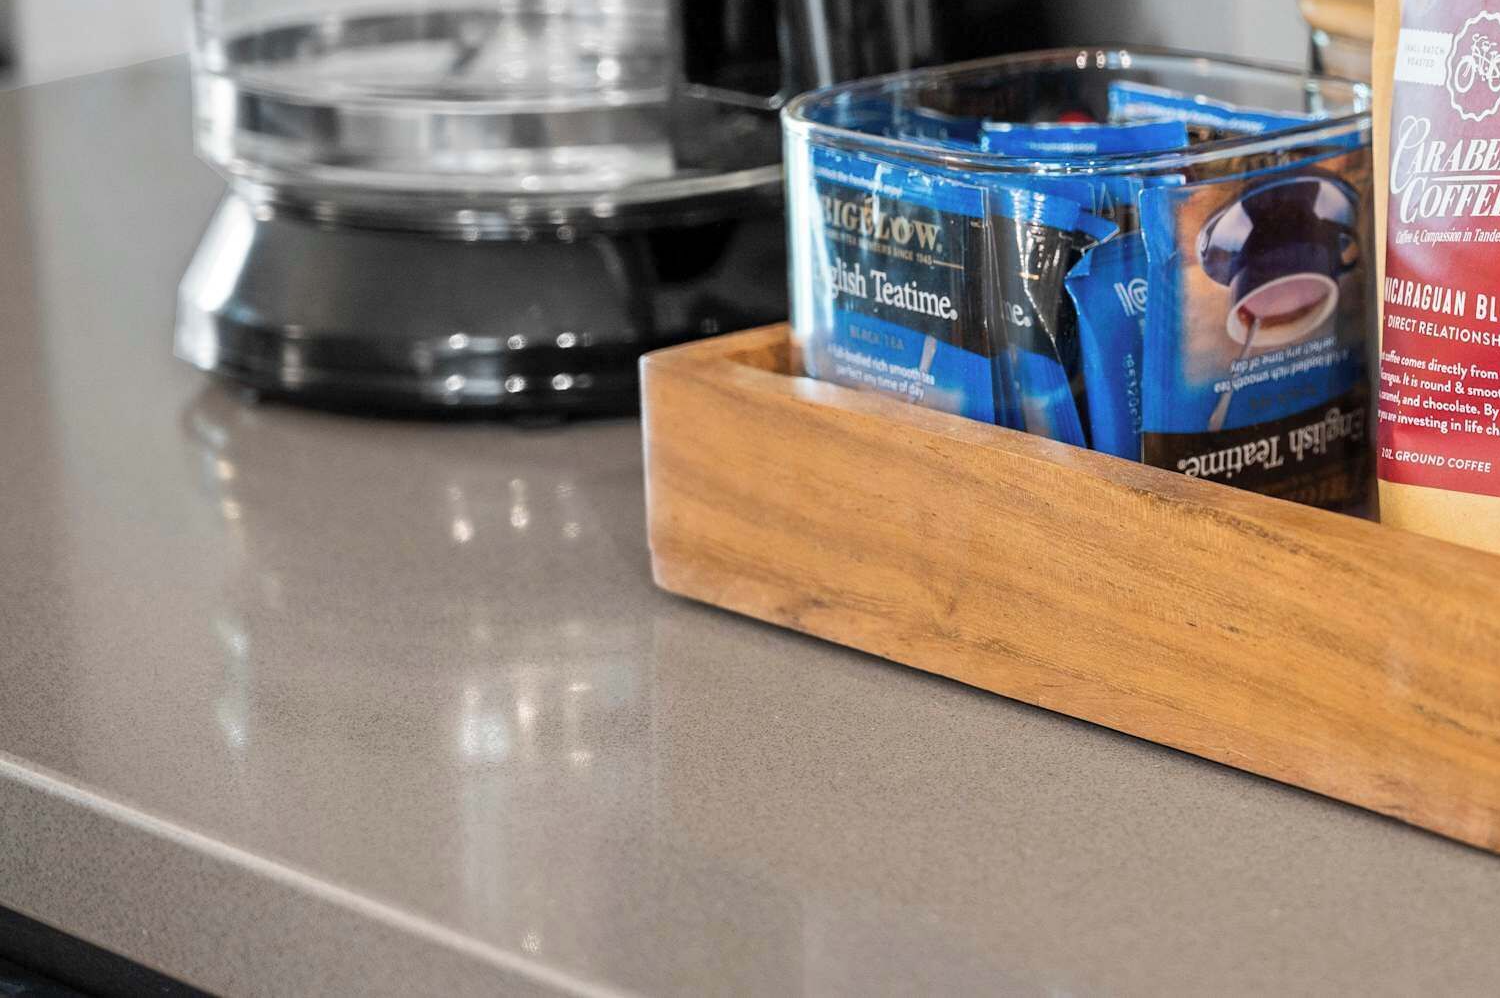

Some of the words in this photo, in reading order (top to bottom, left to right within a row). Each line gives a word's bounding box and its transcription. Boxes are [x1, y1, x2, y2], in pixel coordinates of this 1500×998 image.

[1420, 227, 1461, 247] Compassion
[1463, 227, 1472, 242] in
[831, 256, 867, 300] glish
[870, 269, 952, 319] Teatime
[1384, 276, 1466, 317] NICARAGUAN
[1387, 315, 1416, 333] DIRECT
[1401, 356, 1426, 370] comes
[1428, 358, 1468, 380] directly
[1470, 365, 1499, 379] from
[1402, 372, 1409, 385] It
[1411, 374, 1418, 387] is
[1420, 380, 1451, 393] round
[1455, 381, 1465, 394] &
[1402, 394, 1420, 407] and
[1422, 397, 1480, 416] chocolate.
[1484, 404, 1499, 419] By
[1289, 407, 1365, 461] English
[1398, 410, 1448, 435] investing
[1451, 415, 1461, 431] in
[1464, 419, 1484, 435] life
[1185, 436, 1284, 479] Teatime
[1396, 451, 1445, 466] GROUND
[1448, 458, 1492, 473] COFFEE
